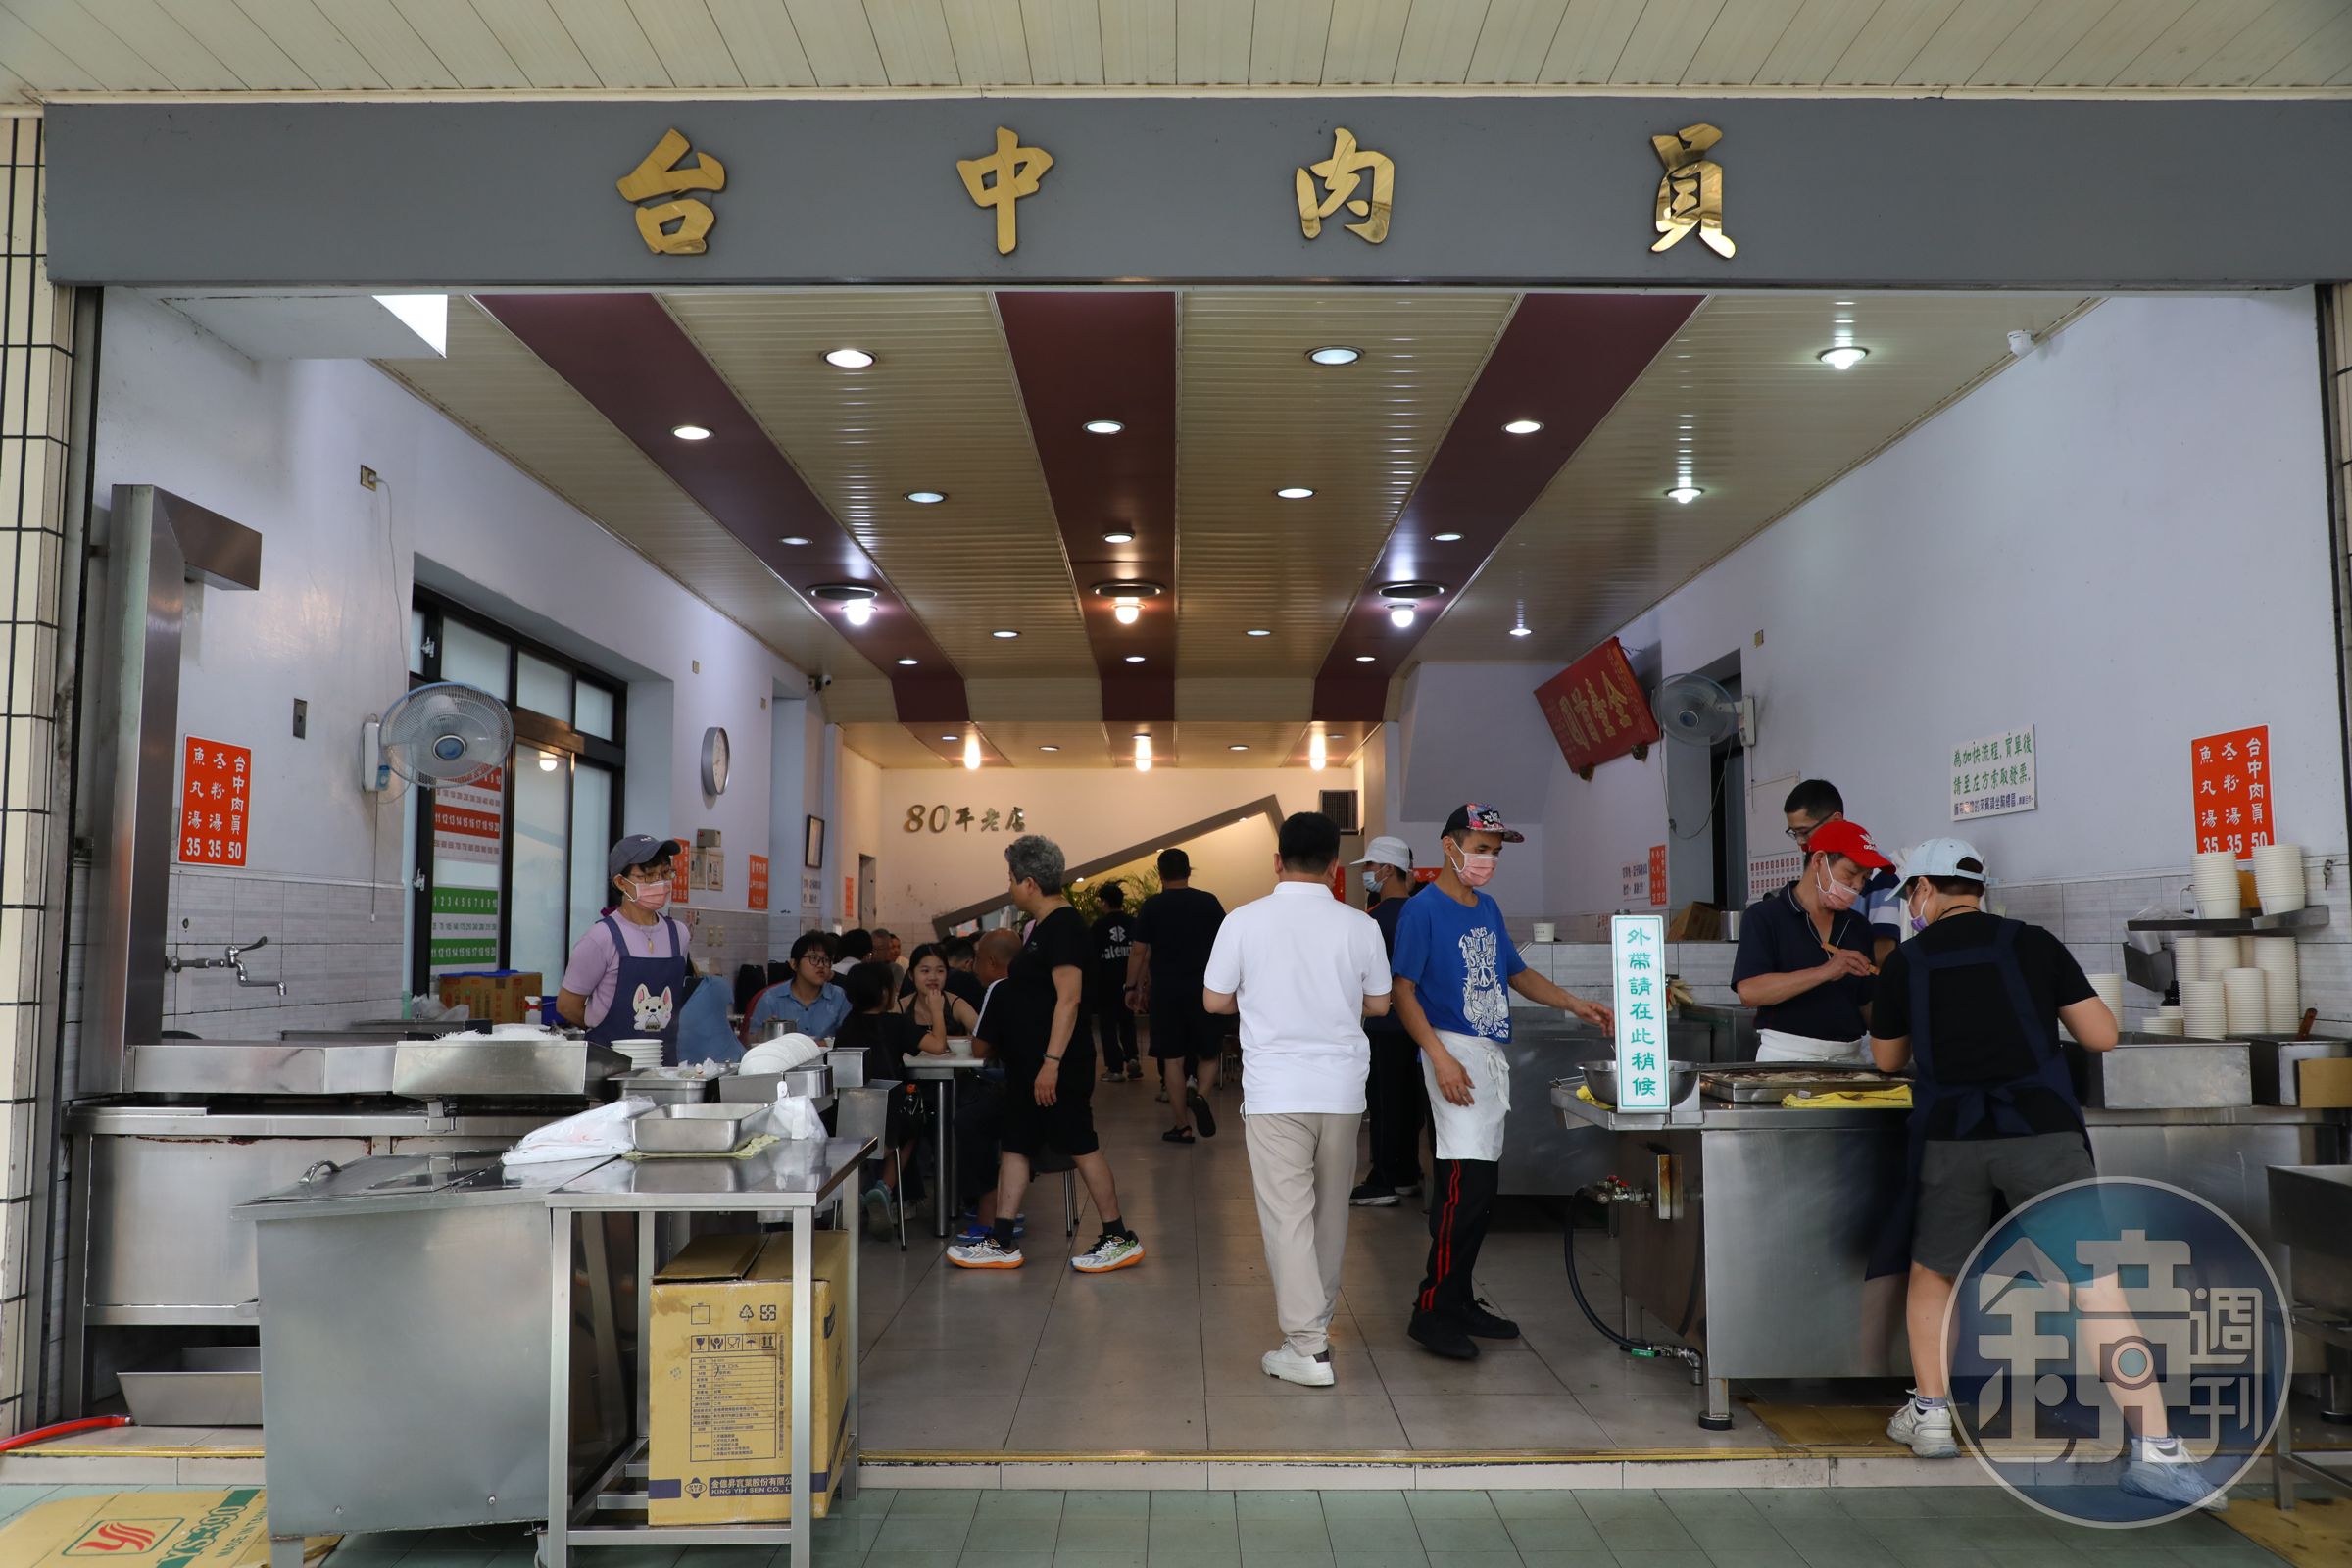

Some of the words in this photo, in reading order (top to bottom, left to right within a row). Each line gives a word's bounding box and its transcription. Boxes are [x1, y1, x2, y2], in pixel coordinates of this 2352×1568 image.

[616, 125, 1737, 259] 台中肉員
[187, 747, 205, 829] 魚丸湯
[209, 752, 227, 832] 冬粉湯
[230, 756, 246, 835] 台中肉員
[903, 804, 1026, 833] 80年老店
[2199, 745, 2218, 828] 魚丸湯
[2221, 742, 2241, 826] 冬粉湯
[2246, 737, 2265, 824] 台中肉員
[186, 837, 201, 856] 35
[208, 839, 221, 858] 35
[228, 841, 242, 859] 50
[2203, 836, 2219, 854] 35
[2227, 834, 2243, 853] 35
[2251, 831, 2268, 847] 50
[1626, 927, 1657, 1097] 外帶請在此稍候
